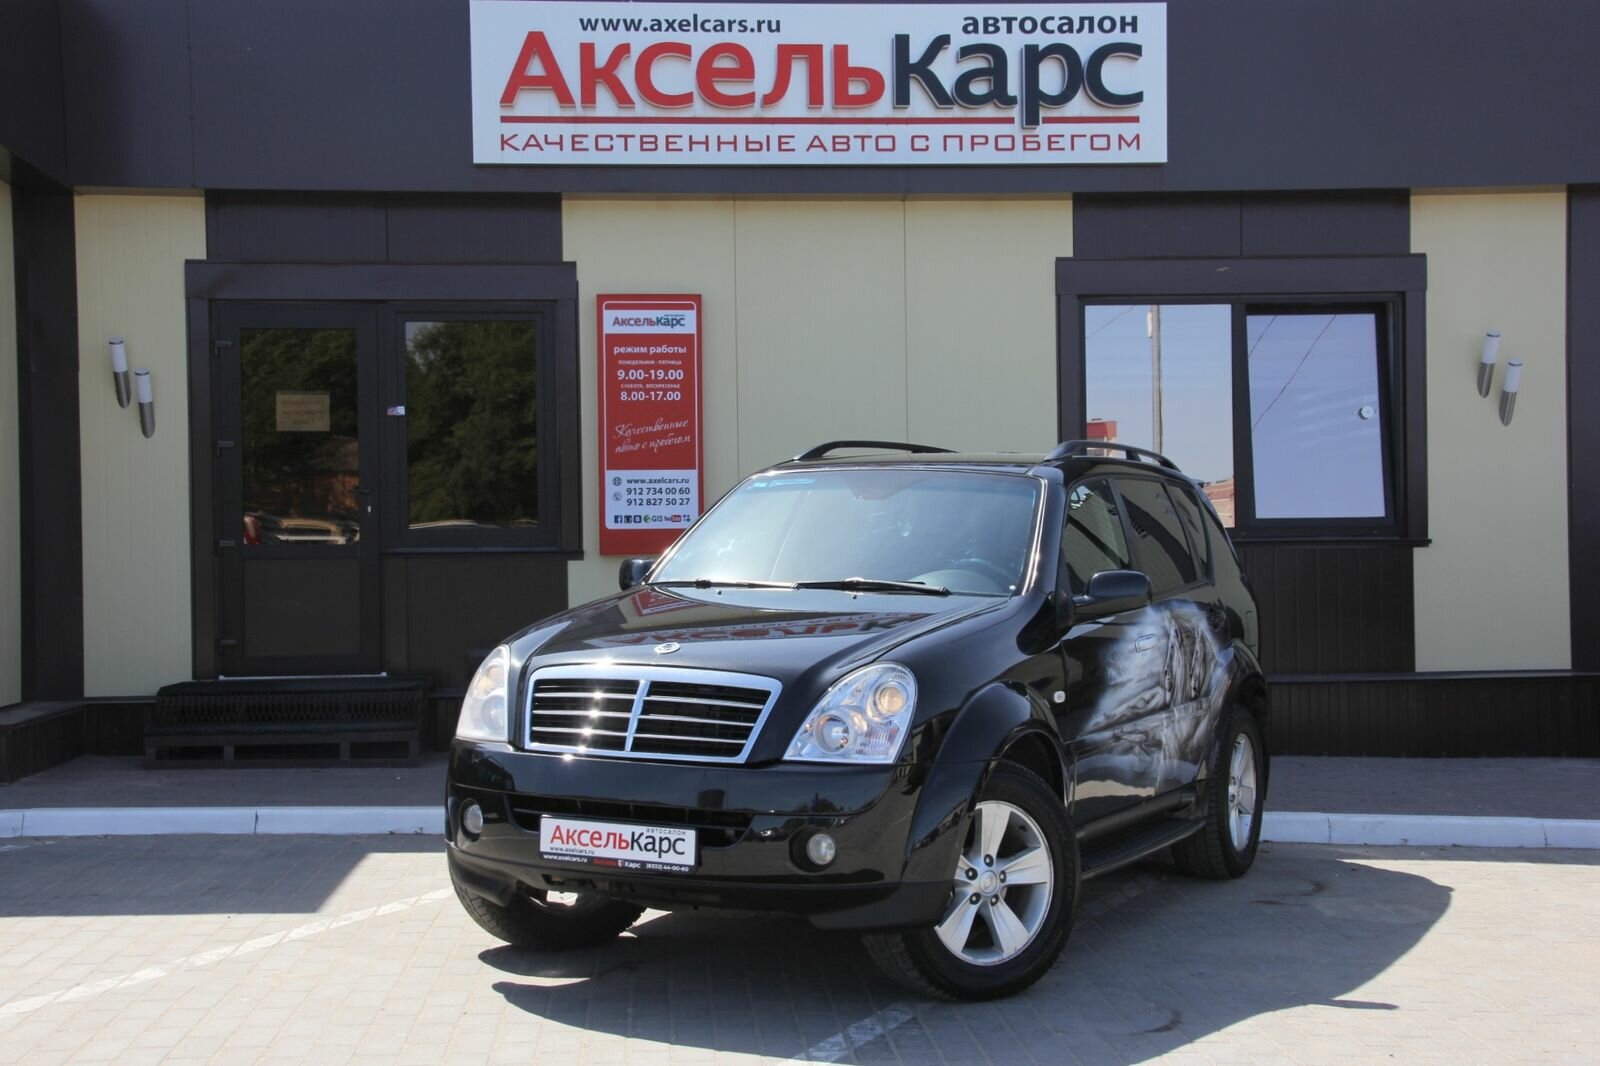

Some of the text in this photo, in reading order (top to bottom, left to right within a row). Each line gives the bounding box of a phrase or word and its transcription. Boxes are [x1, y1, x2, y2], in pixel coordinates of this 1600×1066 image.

[579, 14, 781, 33] www.axelcars.ru
[961, 15, 1139, 34] автосалон
[500, 31, 1144, 128] АксельКарс
[500, 134, 1140, 152] КАЧЕСТВЕННЫЕ АВТО С ПРОБЕГОМ
[613, 345, 687, 355] режим работы
[617, 369, 684, 380] 9.00-19.00
[620, 391, 681, 401] 8.00-17.00
[613, 417, 689, 439] Качественные
[615, 438, 641, 453] авто
[626, 477, 690, 485] www.axelcars.ru
[665, 487, 677, 495] 00
[679, 487, 691, 495] 60
[626, 498, 690, 506] 912 827 50 27
[646, 828, 687, 836] автосалон
[550, 825, 686, 859] АксельКарс
